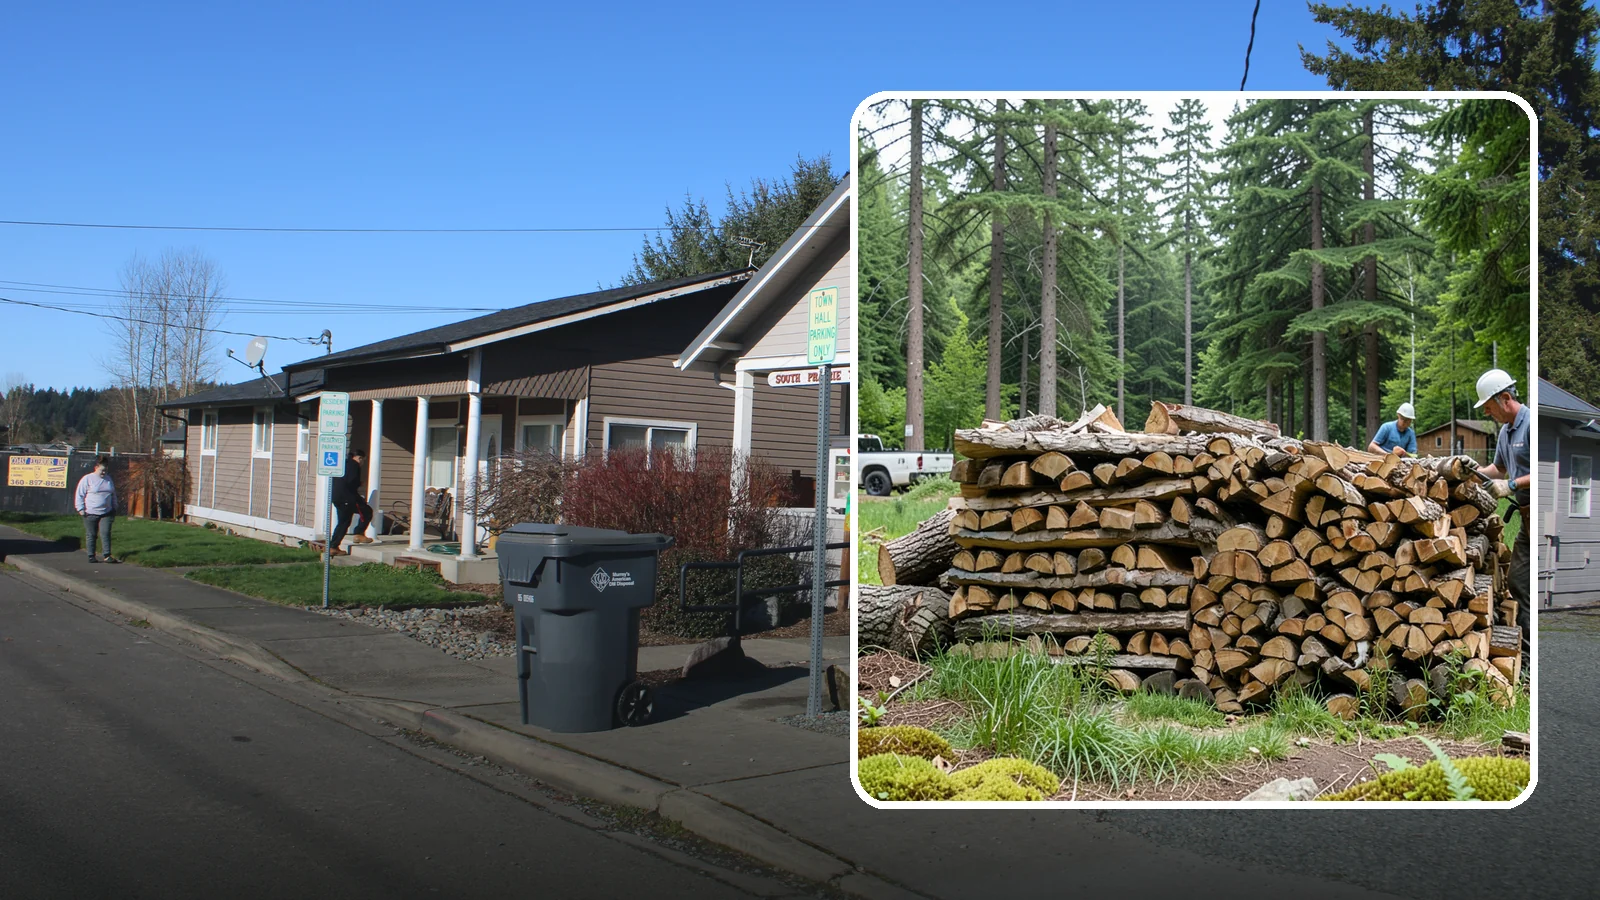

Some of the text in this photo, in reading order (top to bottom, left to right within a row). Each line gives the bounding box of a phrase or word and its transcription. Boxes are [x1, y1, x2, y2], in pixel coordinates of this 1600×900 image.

[815, 295, 833, 307] TOWN
[815, 312, 831, 324] HALL
[810, 326, 836, 340] PARKING
[813, 344, 831, 358] ONLY
[775, 374, 801, 384] SOUTH
[808, 371, 842, 382] PRIE
